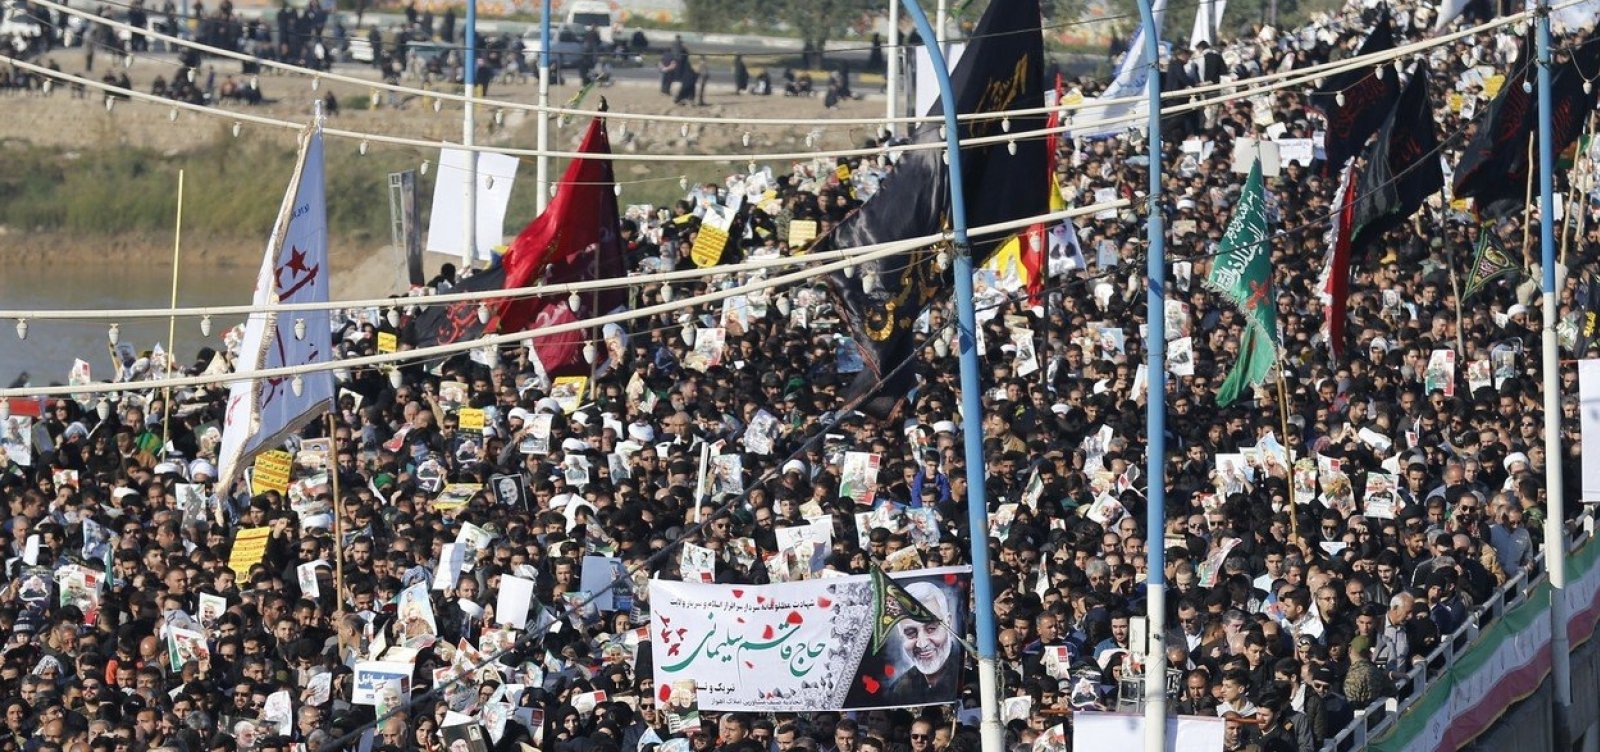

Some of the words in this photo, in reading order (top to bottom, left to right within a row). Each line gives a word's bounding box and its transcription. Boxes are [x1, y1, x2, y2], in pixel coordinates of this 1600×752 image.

[660, 612, 744, 673] سلیمانی
[737, 621, 802, 681] قاسم
[790, 642, 826, 677] حاج
[714, 682, 736, 694] تبریک
